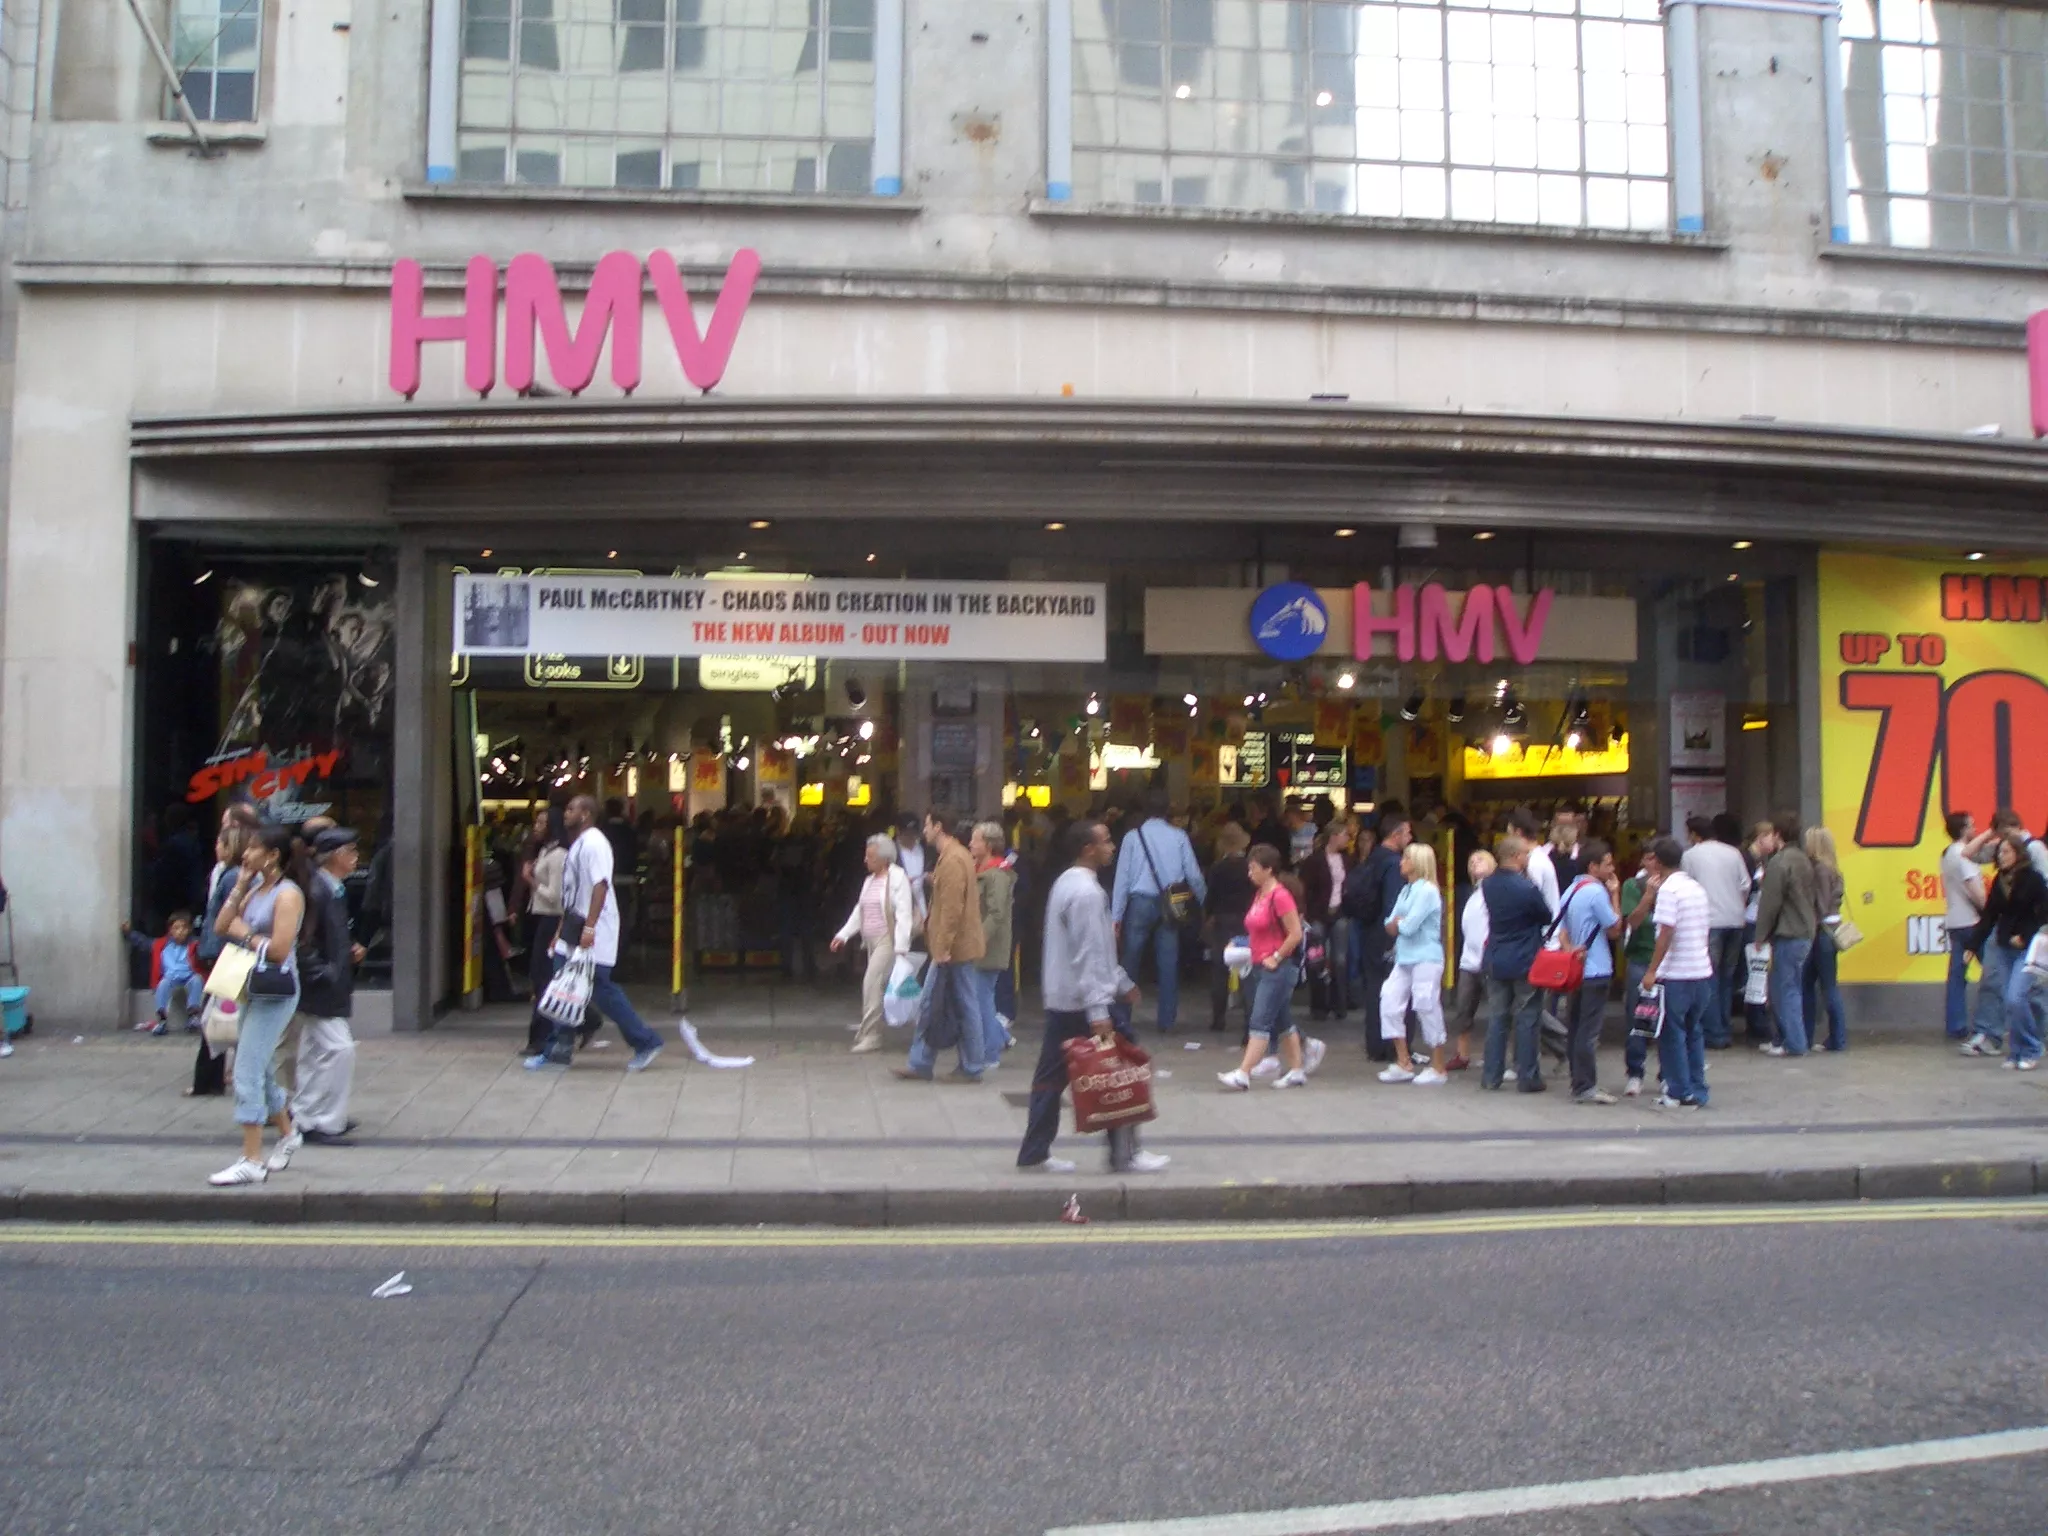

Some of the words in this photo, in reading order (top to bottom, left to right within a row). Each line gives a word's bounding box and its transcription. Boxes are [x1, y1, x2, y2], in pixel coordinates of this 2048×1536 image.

[388, 248, 762, 394] HMV
[539, 588, 586, 610] PAUL
[590, 588, 706, 612] McCARTNEY
[722, 589, 788, 612] CHAOS
[791, 591, 831, 613] AND
[836, 591, 928, 614] CREATION
[932, 592, 952, 613] IN
[959, 593, 992, 614] THE
[996, 594, 1096, 616] BACKYARD
[1353, 581, 1555, 664] HMV
[1941, 572, 2048, 623] HM
[692, 621, 727, 642] THE
[732, 622, 775, 643] NEW
[779, 622, 845, 643] ALBUM
[862, 623, 900, 645] OUT
[904, 623, 950, 646] NOW
[1840, 632, 1890, 664] UP
[1897, 633, 1945, 665] TO
[184, 751, 268, 804] SIN
[251, 747, 340, 799] CITY
[1840, 670, 2048, 848] 70
[1907, 914, 1952, 956] NE
